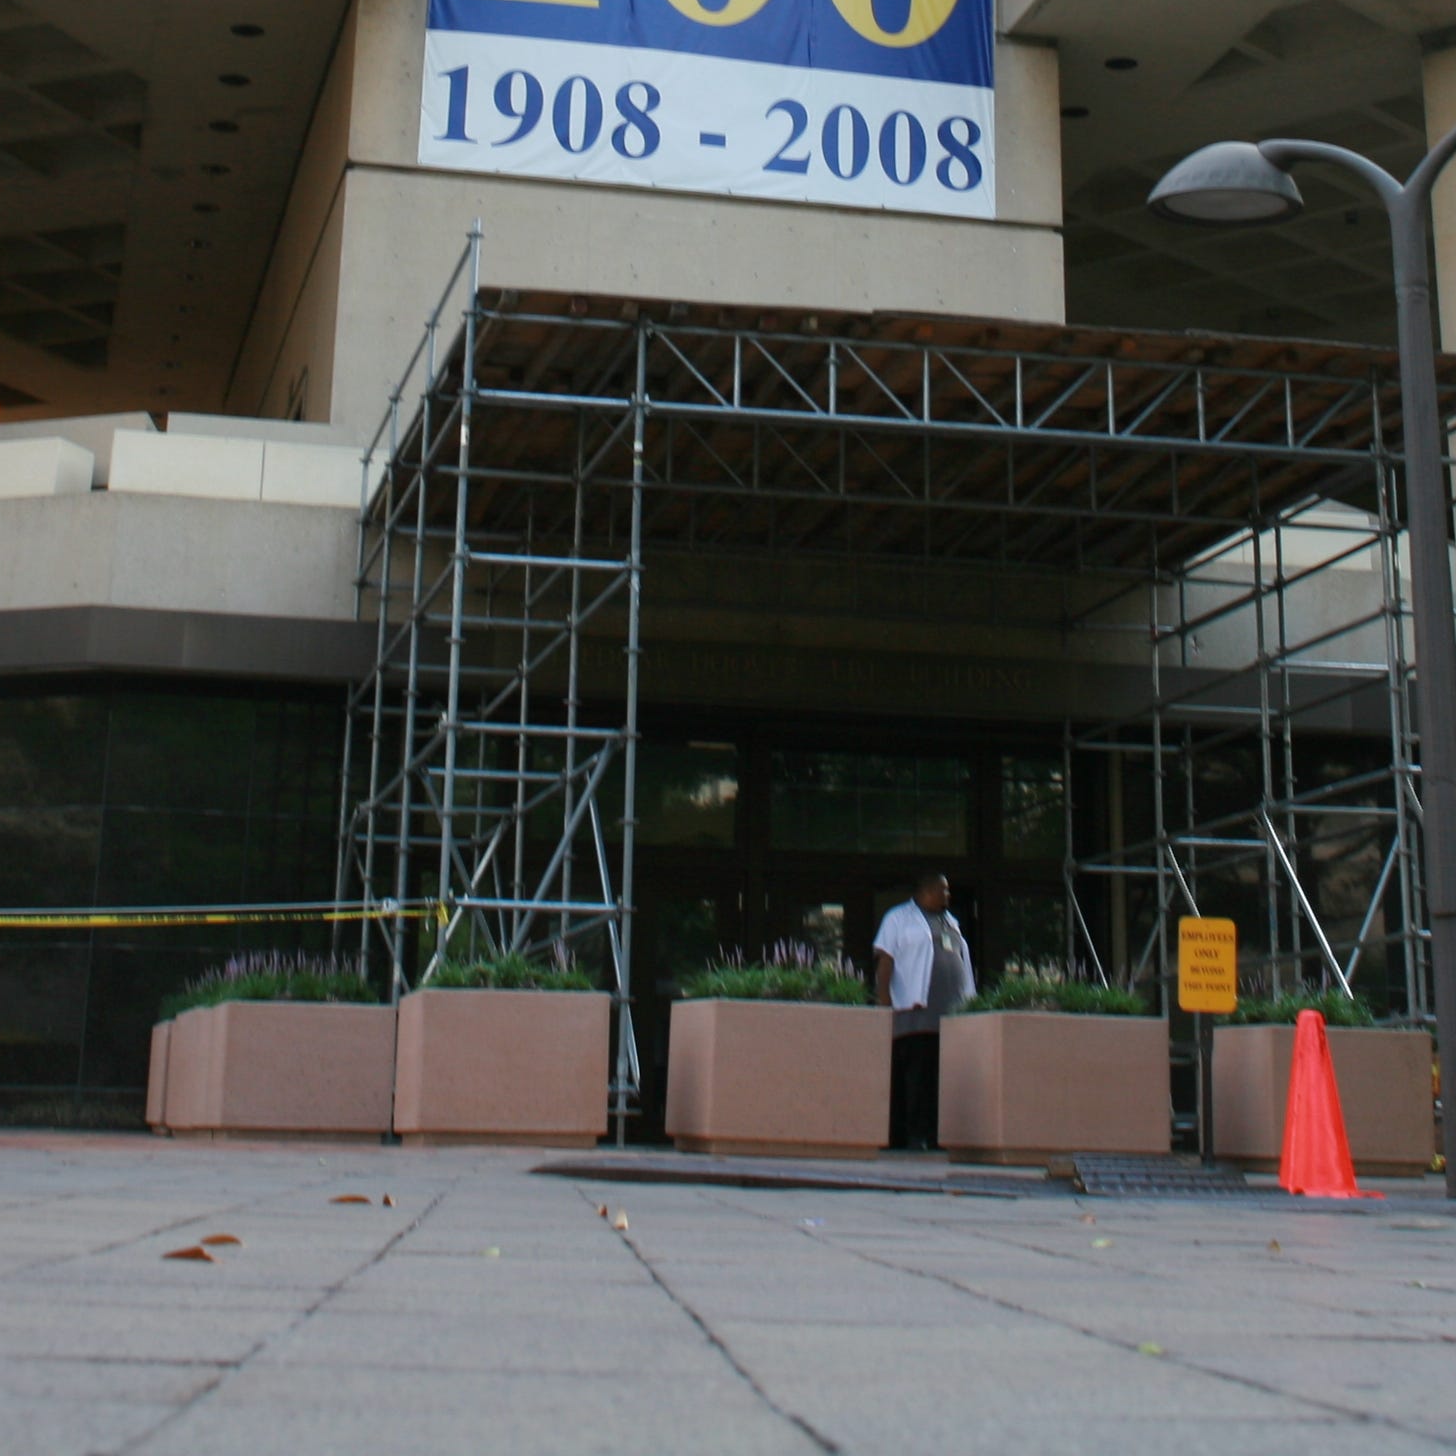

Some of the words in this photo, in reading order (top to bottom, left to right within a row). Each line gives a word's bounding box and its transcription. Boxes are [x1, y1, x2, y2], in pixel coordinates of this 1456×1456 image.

[433, 64, 661, 158] 1908
[762, 99, 983, 191] 2008
[1181, 931, 1234, 943] EMPLOYEES
[1194, 948, 1220, 960] ONLY
